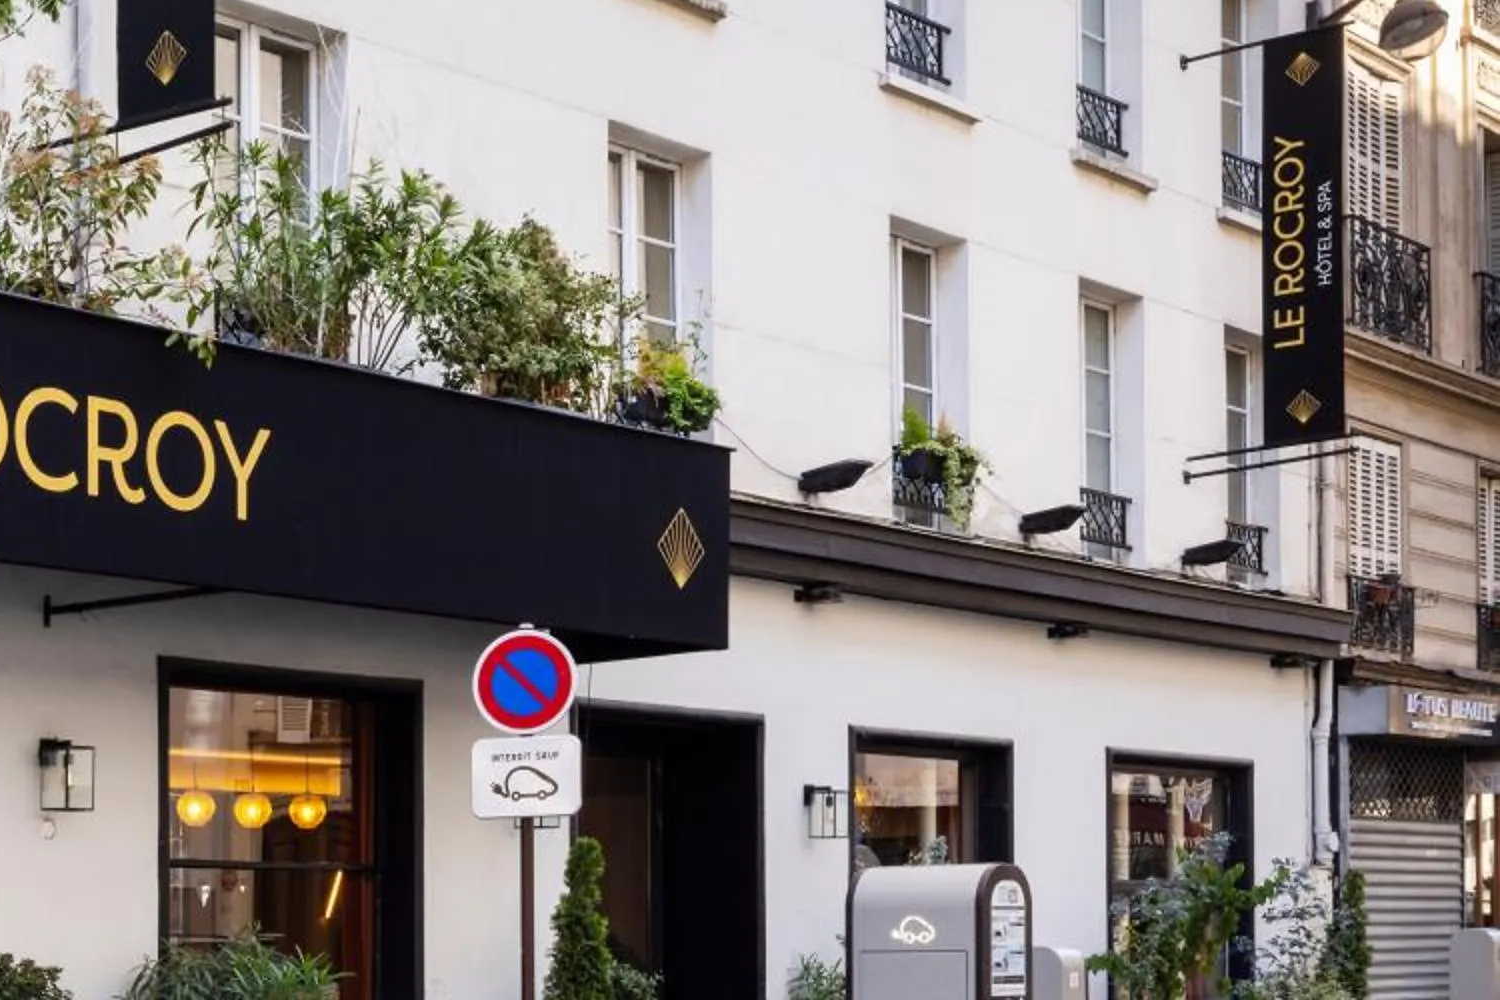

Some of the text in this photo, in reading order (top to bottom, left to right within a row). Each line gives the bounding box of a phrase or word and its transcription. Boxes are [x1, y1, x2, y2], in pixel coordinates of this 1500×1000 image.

[1273, 135, 1305, 349] LE ROCROY
[1314, 180, 1333, 287] HÔTEL & SPA
